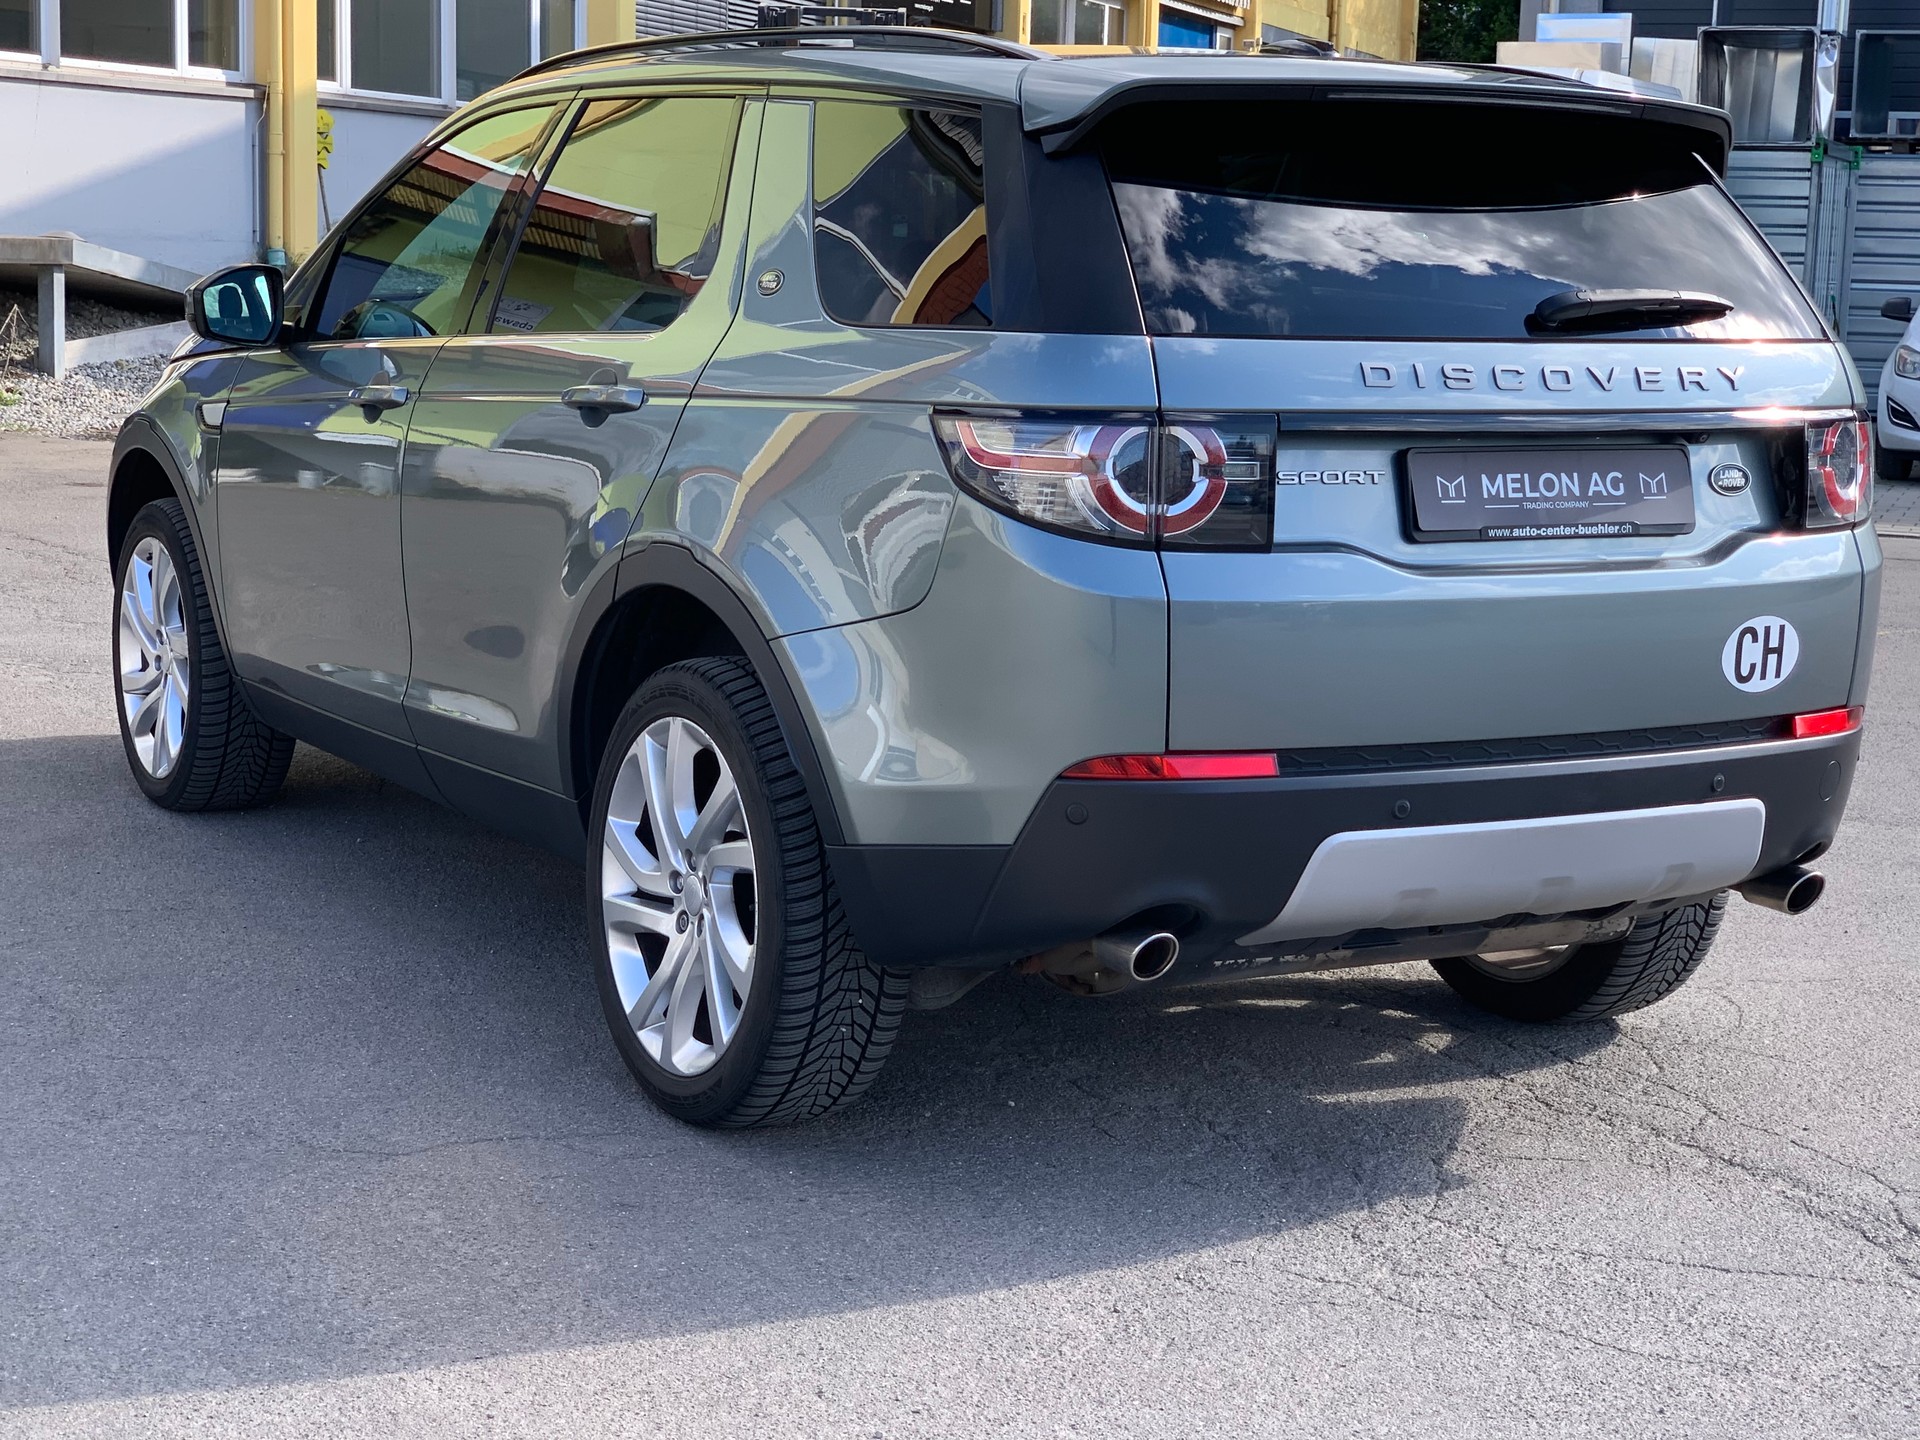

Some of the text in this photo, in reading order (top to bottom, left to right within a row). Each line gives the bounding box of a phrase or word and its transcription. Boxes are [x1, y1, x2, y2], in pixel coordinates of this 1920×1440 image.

[1360, 361, 1745, 392] DISCOVERY
[1276, 470, 1386, 485] SPORT
[1719, 469, 1738, 478] LAND
[1481, 471, 1625, 498] MELON AG
[1722, 478, 1746, 487] ROVER
[1555, 501, 1590, 509] COMPANY
[1488, 522, 1633, 538] www.auto-center-buehler.ch
[1734, 624, 1786, 684] CH
